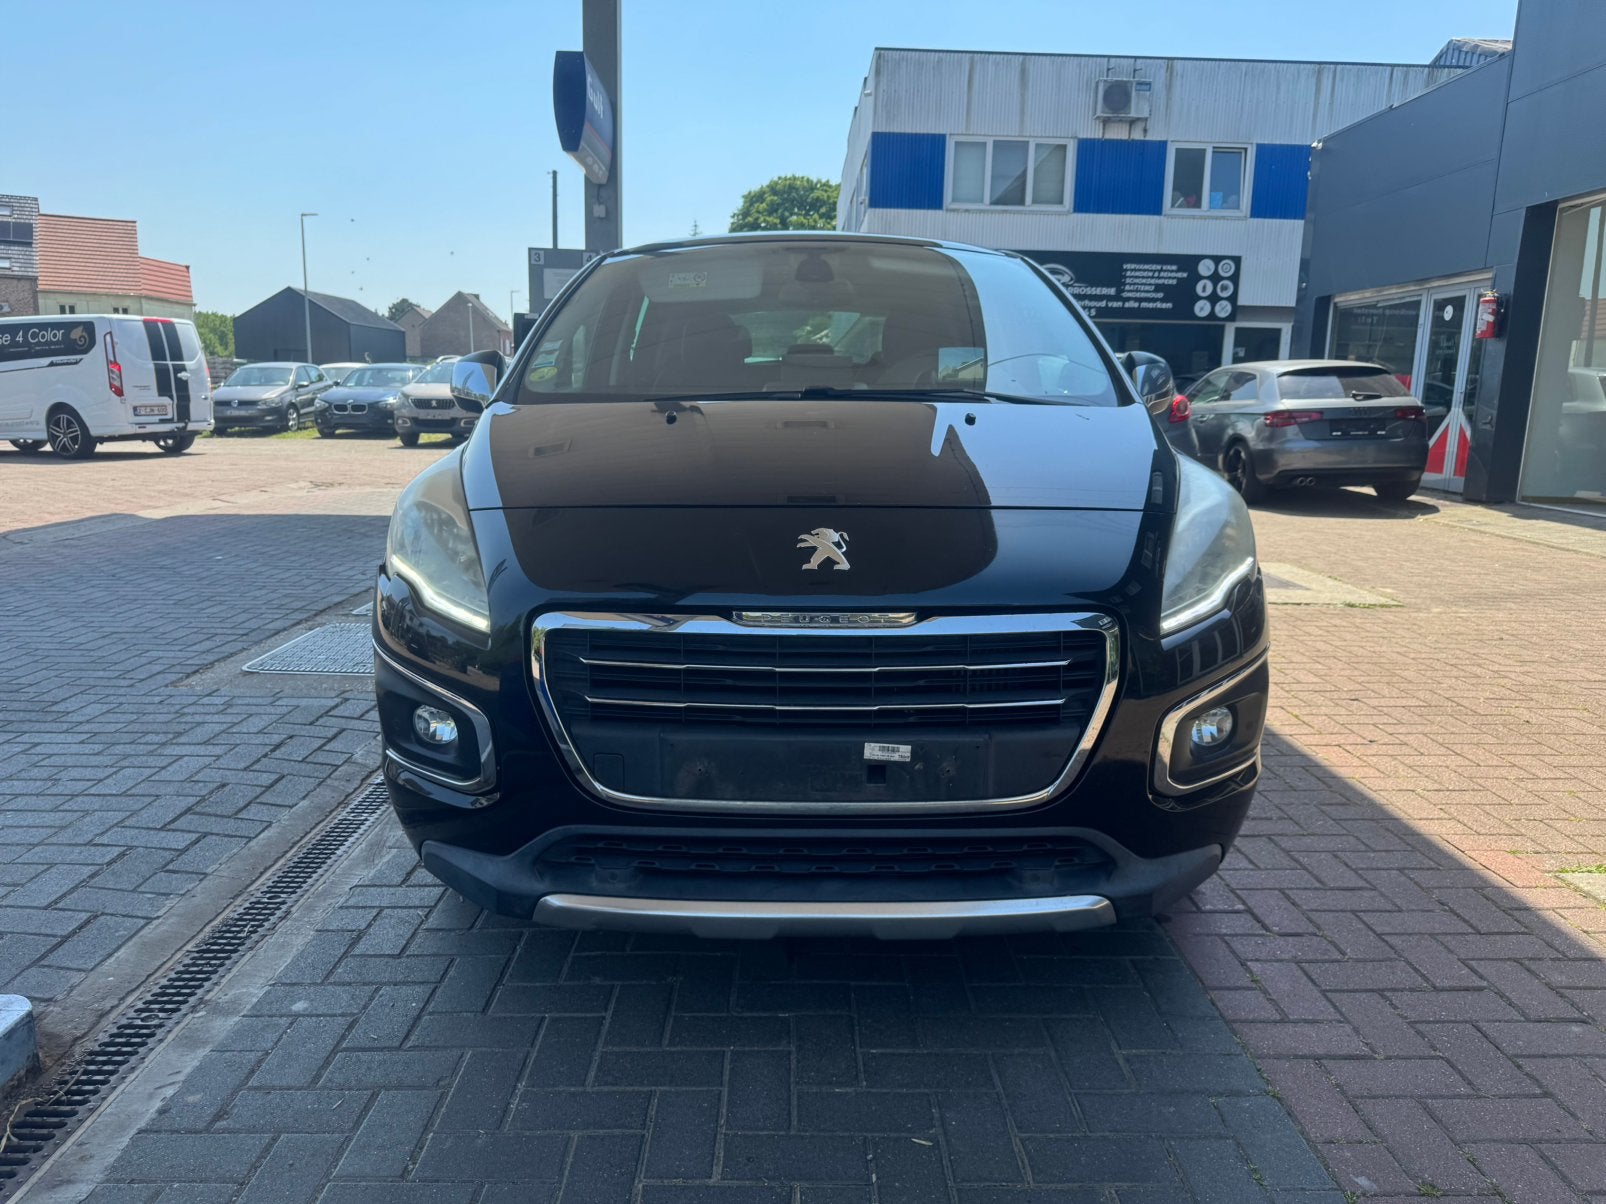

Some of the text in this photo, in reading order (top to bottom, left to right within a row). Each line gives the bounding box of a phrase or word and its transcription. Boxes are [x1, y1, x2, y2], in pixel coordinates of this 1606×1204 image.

[534, 252, 541, 263] 3
[1066, 286, 1116, 295] RROSSERIE
[1124, 300, 1139, 308] alle
[1140, 301, 1173, 309] merken
[15, 329, 24, 343] 4
[28, 327, 65, 343] Color
[761, 613, 889, 623] PEUGEOT
